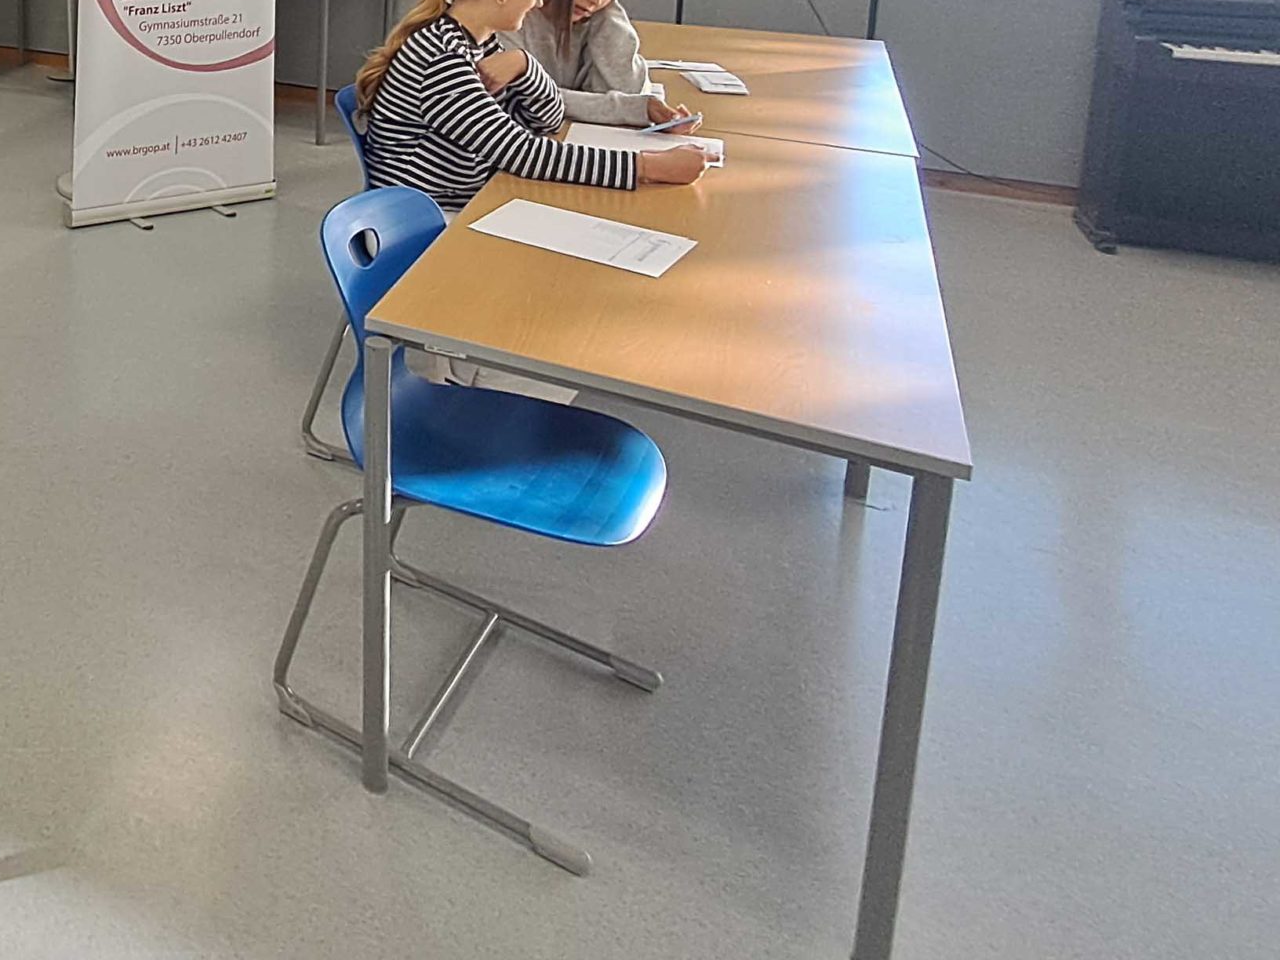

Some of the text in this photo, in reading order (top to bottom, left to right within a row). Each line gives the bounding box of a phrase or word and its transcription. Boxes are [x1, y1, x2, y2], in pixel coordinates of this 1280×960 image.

[123, 1, 191, 16] "Franz Liszt"
[138, 13, 242, 33] Gymnasiumstraße 21
[157, 27, 261, 46] 7350 Oberpullendorf
[106, 142, 170, 158] www.brgop.at
[180, 138, 197, 148] +43
[199, 135, 219, 147] 2612
[221, 132, 247, 143] 42407
